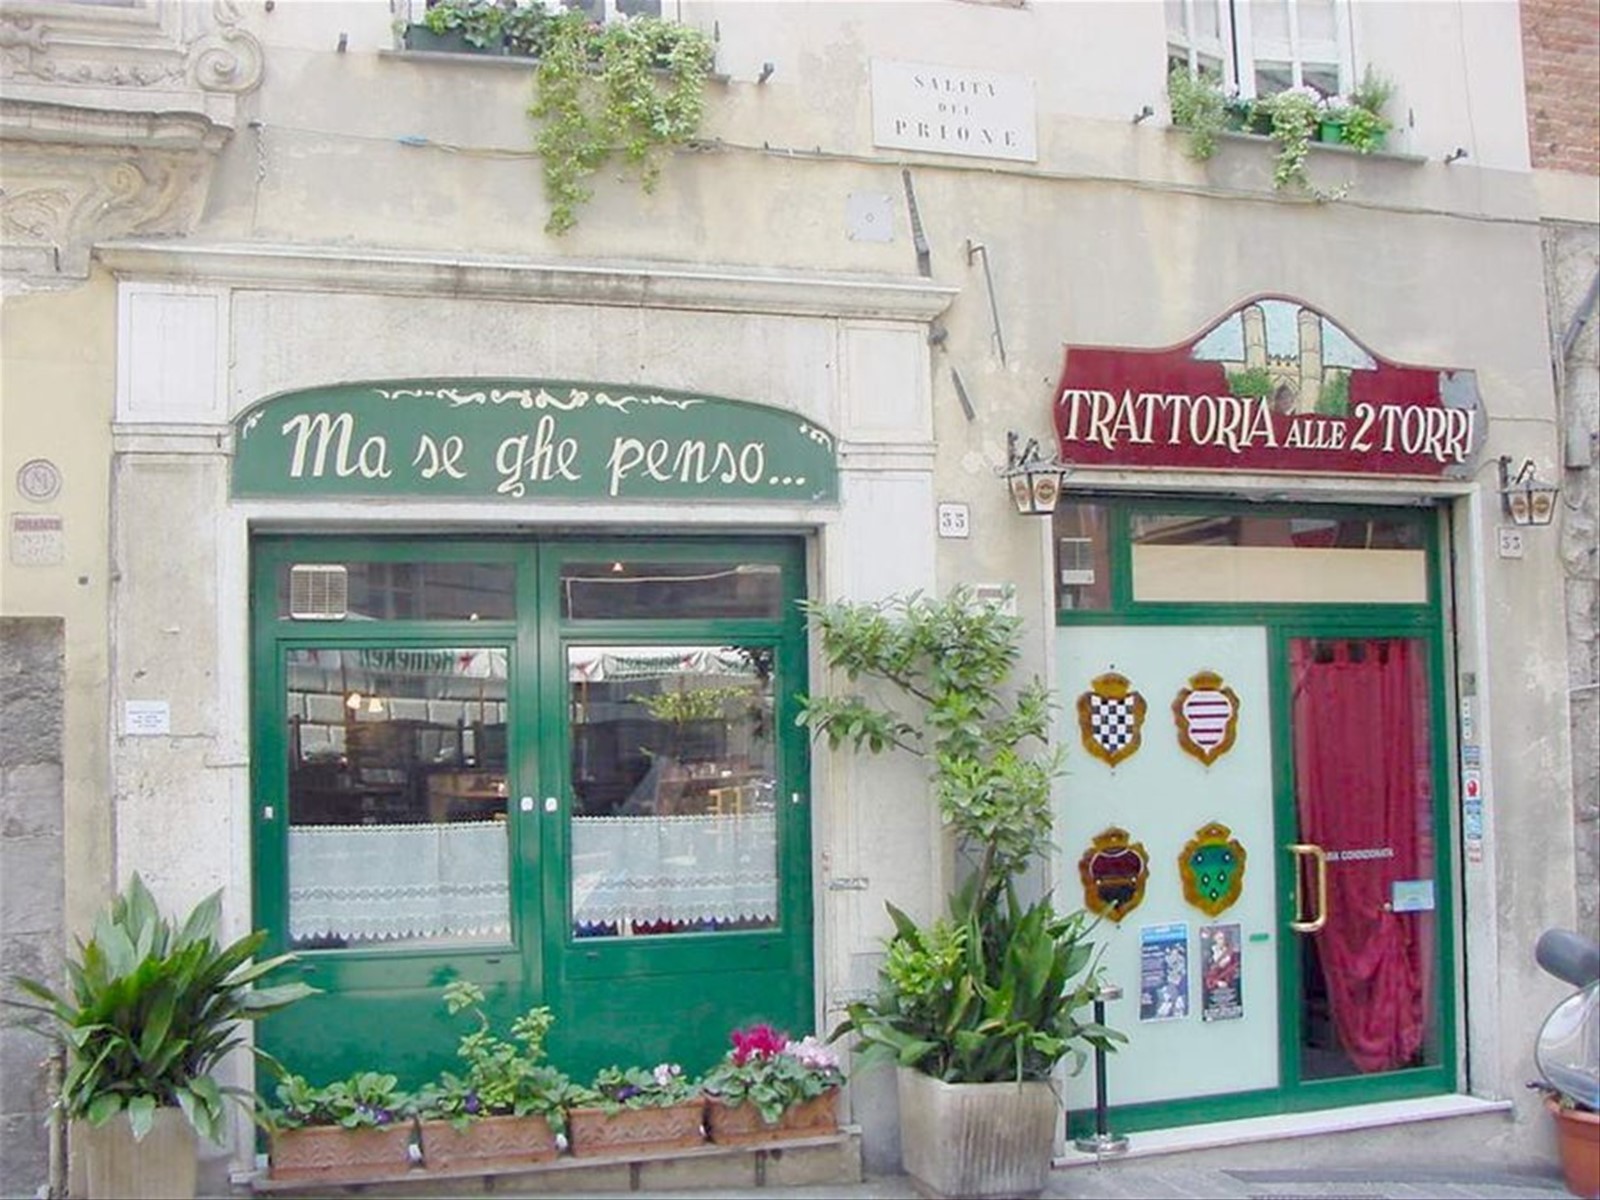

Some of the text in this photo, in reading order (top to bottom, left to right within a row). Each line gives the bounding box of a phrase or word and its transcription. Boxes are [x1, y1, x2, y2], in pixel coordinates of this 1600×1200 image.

[914, 75, 995, 97] SALITA
[895, 118, 1017, 147] PRIONE
[1060, 388, 1478, 463] TRATTORIA ALLE 2 TORRI
[282, 412, 806, 498] Ma se ghe penso...
